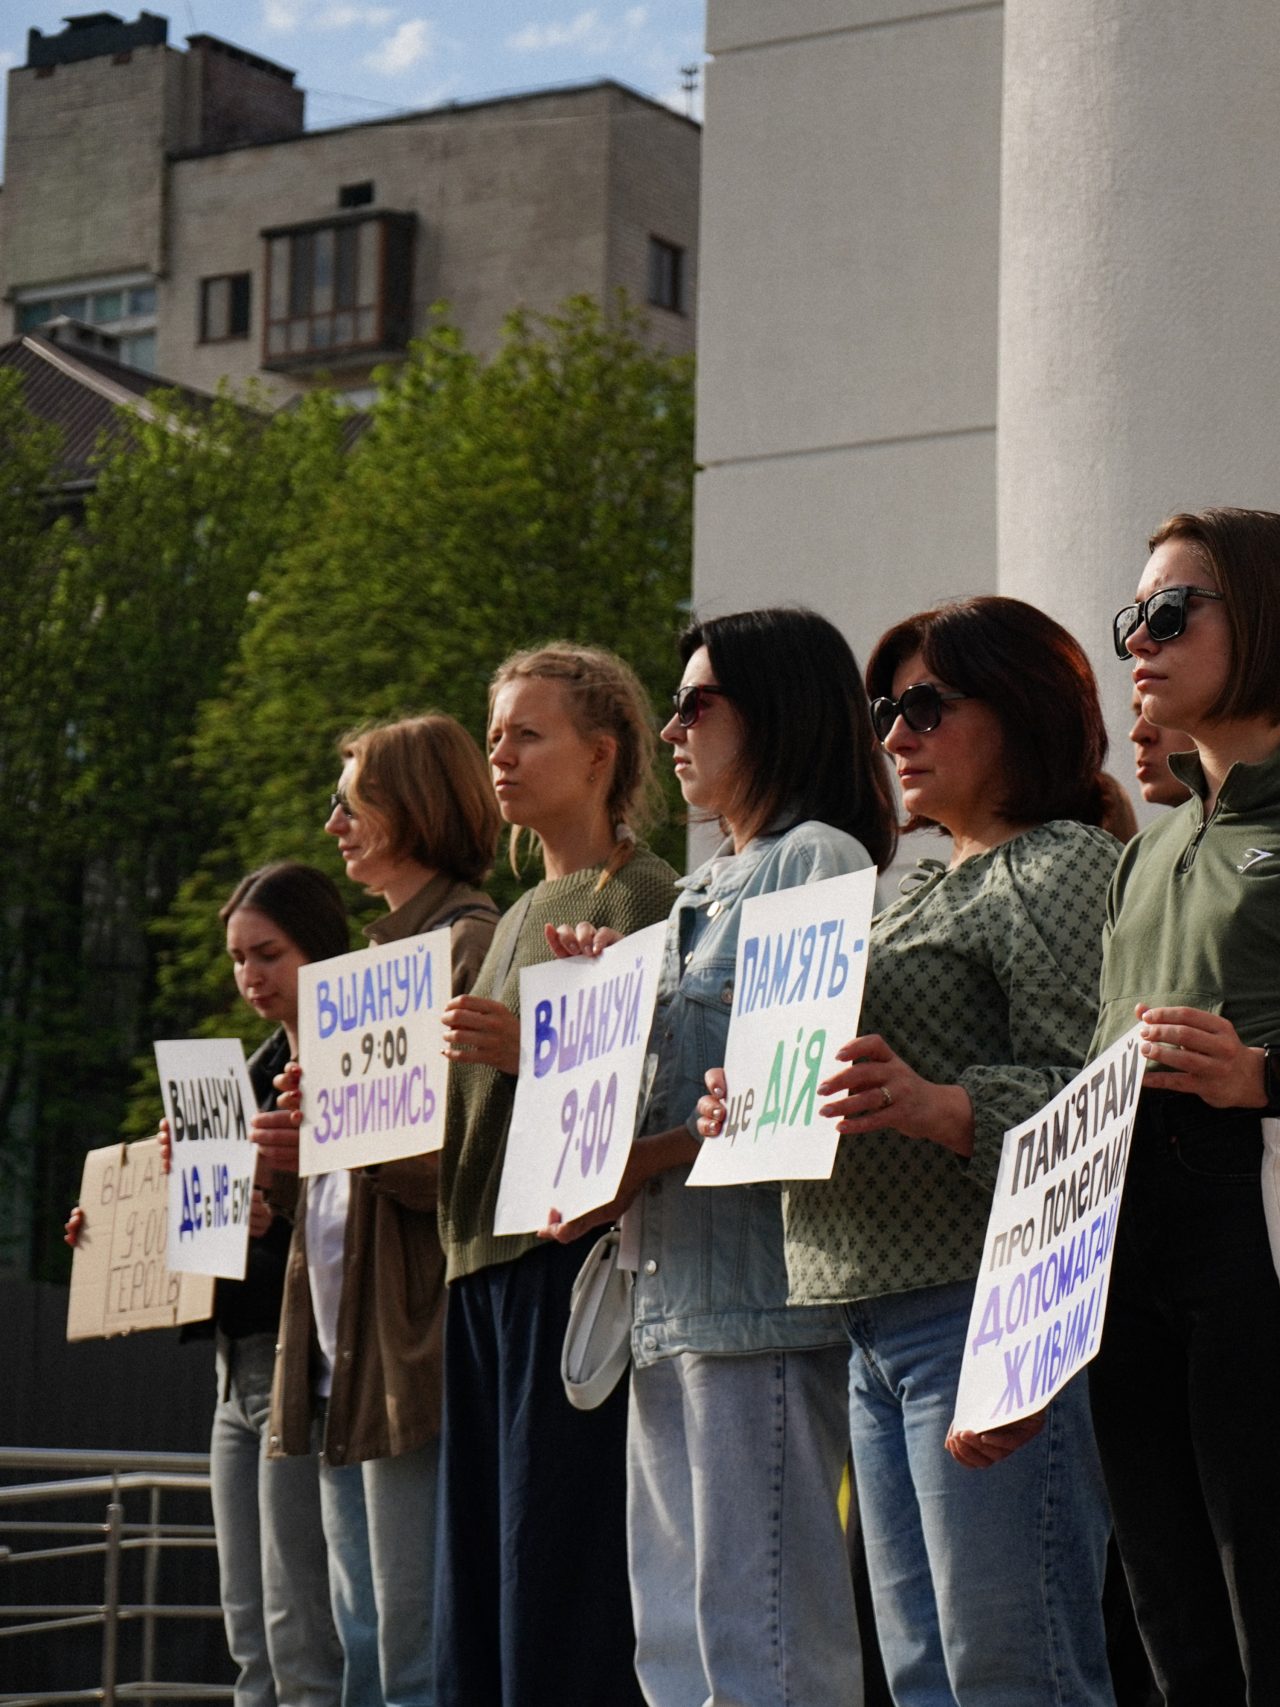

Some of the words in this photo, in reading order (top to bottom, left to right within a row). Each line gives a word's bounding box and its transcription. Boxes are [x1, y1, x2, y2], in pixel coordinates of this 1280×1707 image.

[316, 944, 433, 1039] ВШАНУЙ
[361, 1026, 408, 1075] 9:00
[168, 1068, 248, 1142] ВШАНУЙ
[313, 1064, 436, 1144] ЗУПИНИСЬ
[553, 1071, 618, 1189] 9:00
[1010, 1043, 1140, 1196] ПАМ'ЯТАЙ
[120, 1206, 168, 1259] 9:00
[971, 1194, 1120, 1356] ДОПОМАГАЙ
[989, 1216, 1035, 1273] ПРО
[989, 1273, 1105, 1420] ЖИВИМ!
